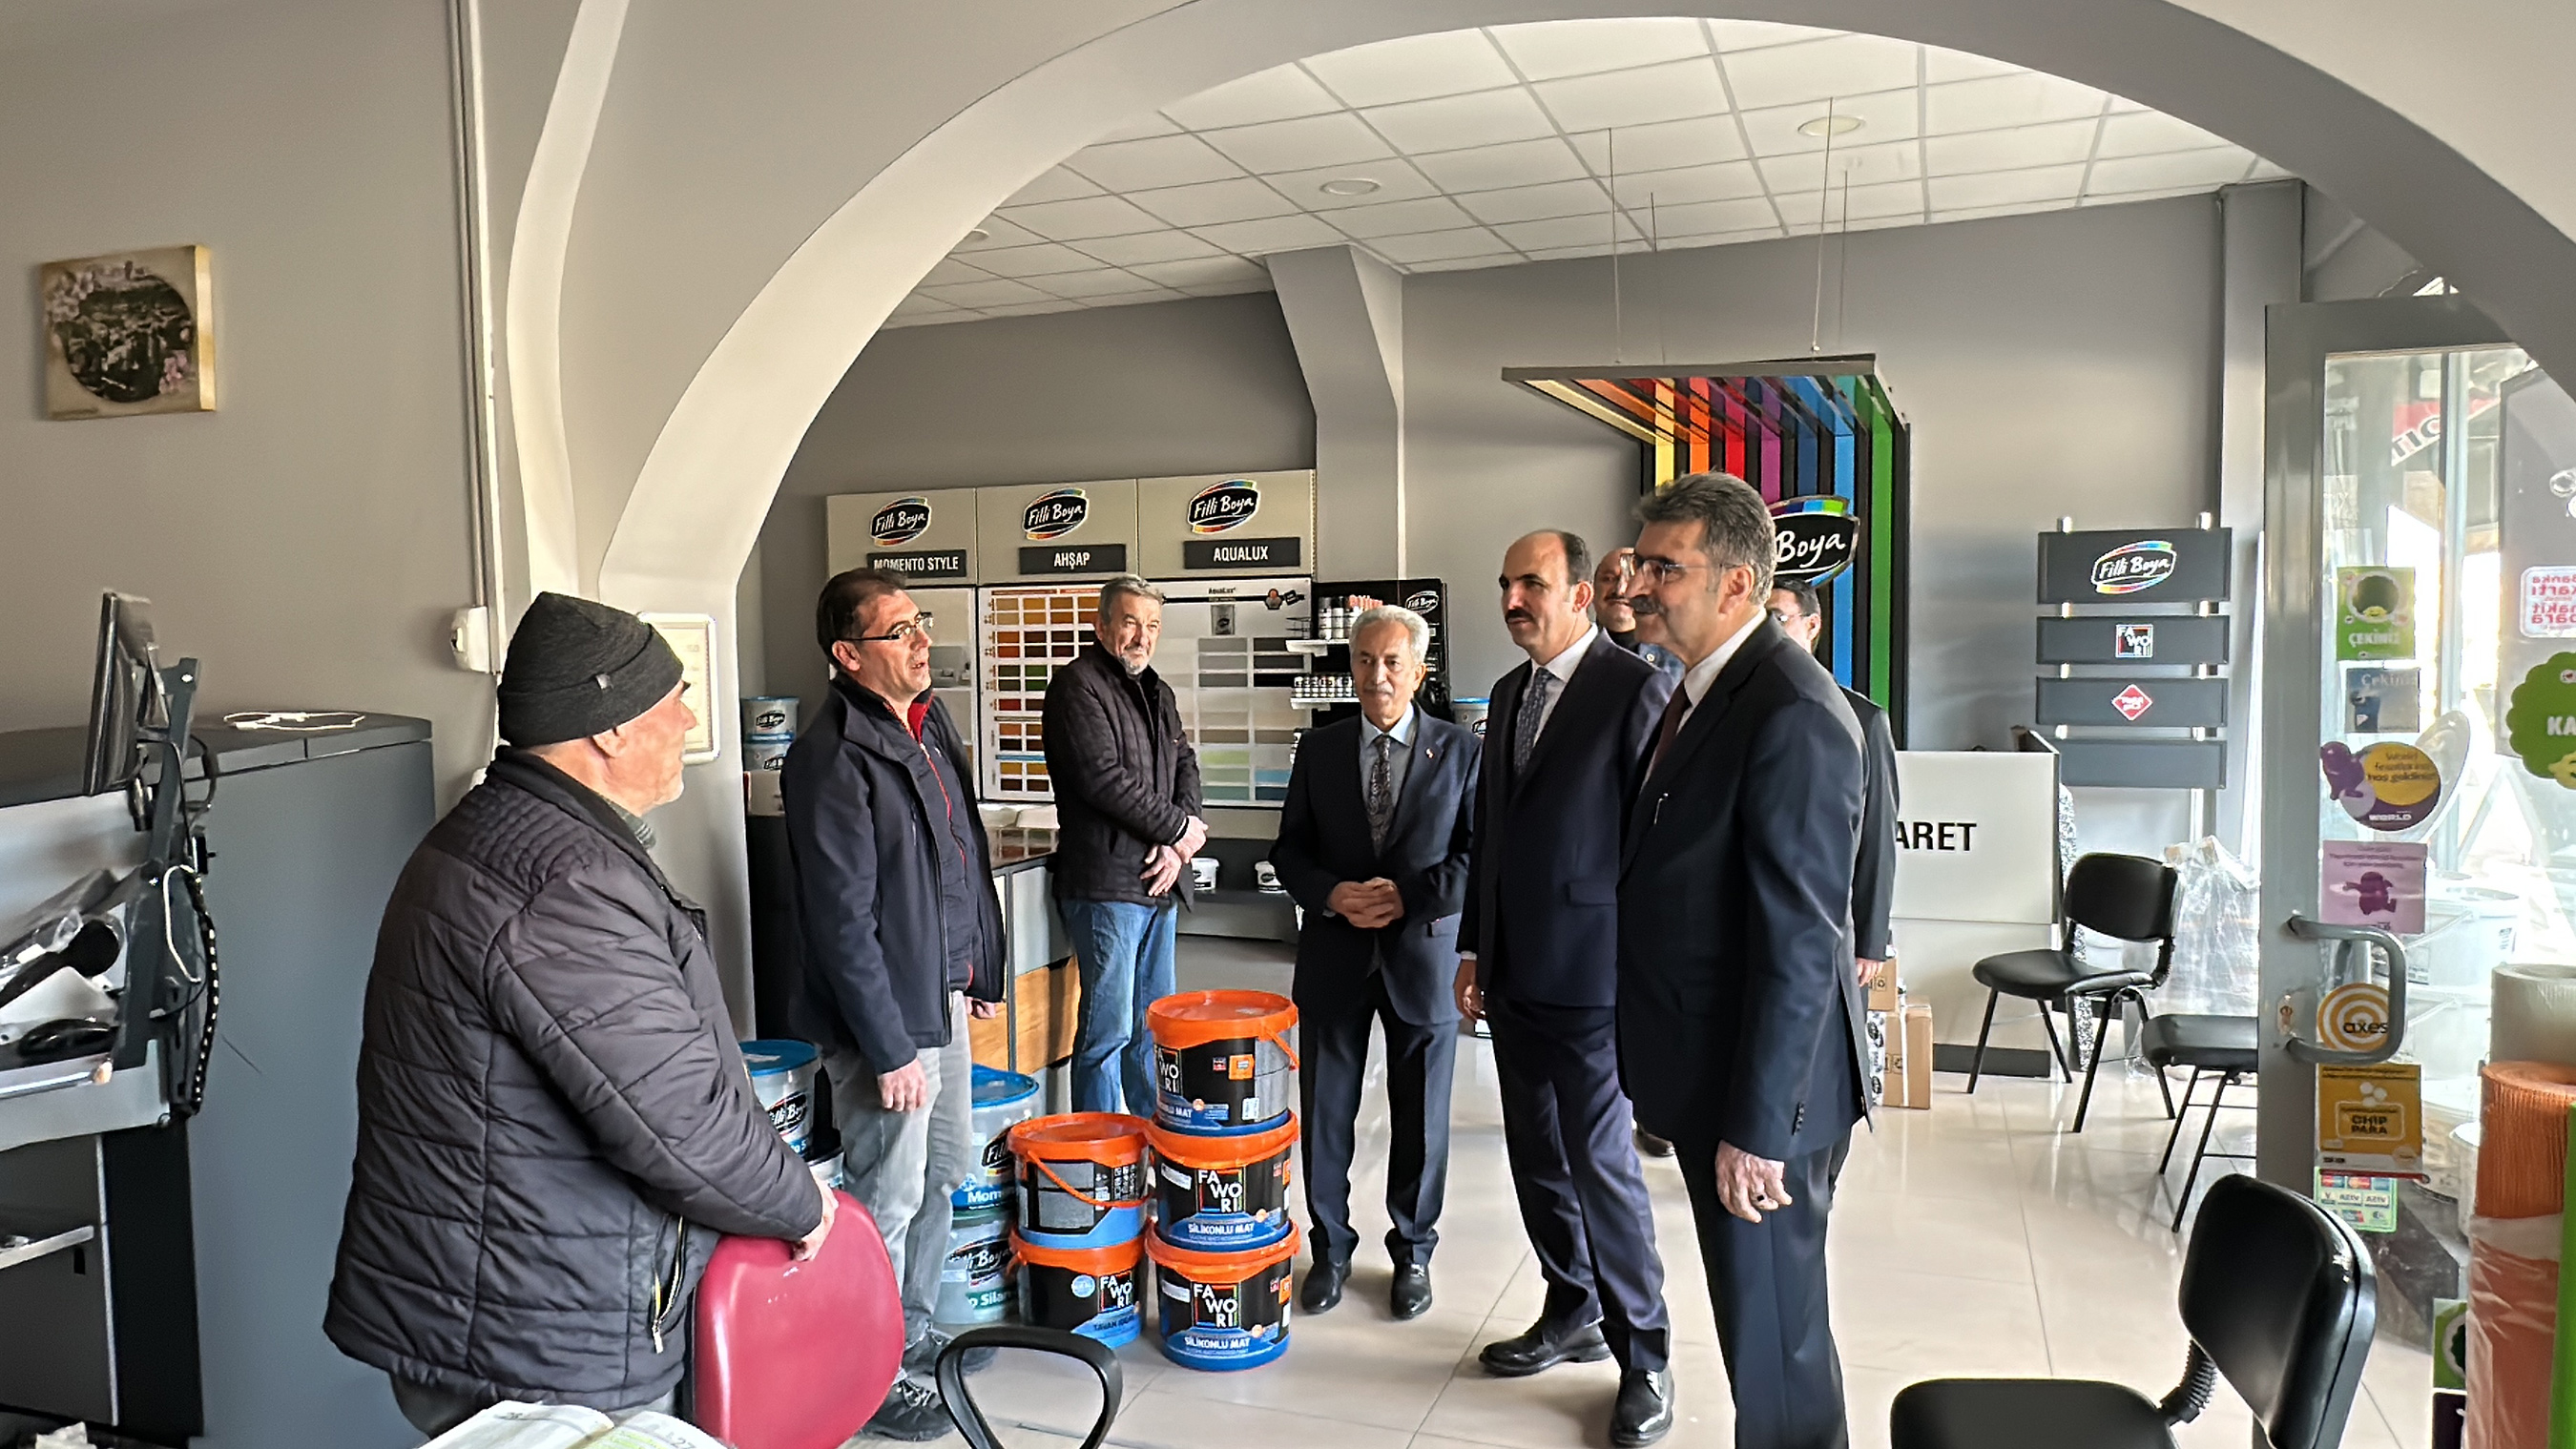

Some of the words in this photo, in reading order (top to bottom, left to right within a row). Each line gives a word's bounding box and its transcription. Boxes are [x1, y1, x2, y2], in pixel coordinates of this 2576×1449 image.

[1028, 506, 1050, 526] Filli
[1052, 504, 1083, 523] Boya
[1195, 496, 1217, 519] Filli
[1220, 495, 1254, 516] Boya
[875, 512, 895, 532] Filli
[898, 511, 925, 529] Boya
[1214, 546, 1269, 562] AQUALUX
[1776, 530, 1846, 568] Boya
[874, 558, 924, 571] MOMENTO
[927, 556, 959, 570] STYLE
[1054, 552, 1091, 570] AHŞAP
[2099, 558, 2128, 579] Filli
[2129, 556, 2171, 576] Boya
[1896, 821, 1977, 851] ARET
[2343, 1023, 2388, 1033] axes
[1198, 1170, 1219, 1184] FA
[1210, 1183, 1242, 1198] WO
[1100, 1275, 1117, 1291] FA
[1111, 1282, 1132, 1298] WO
[1194, 1284, 1215, 1298] FA
[1205, 1299, 1237, 1314] WO
